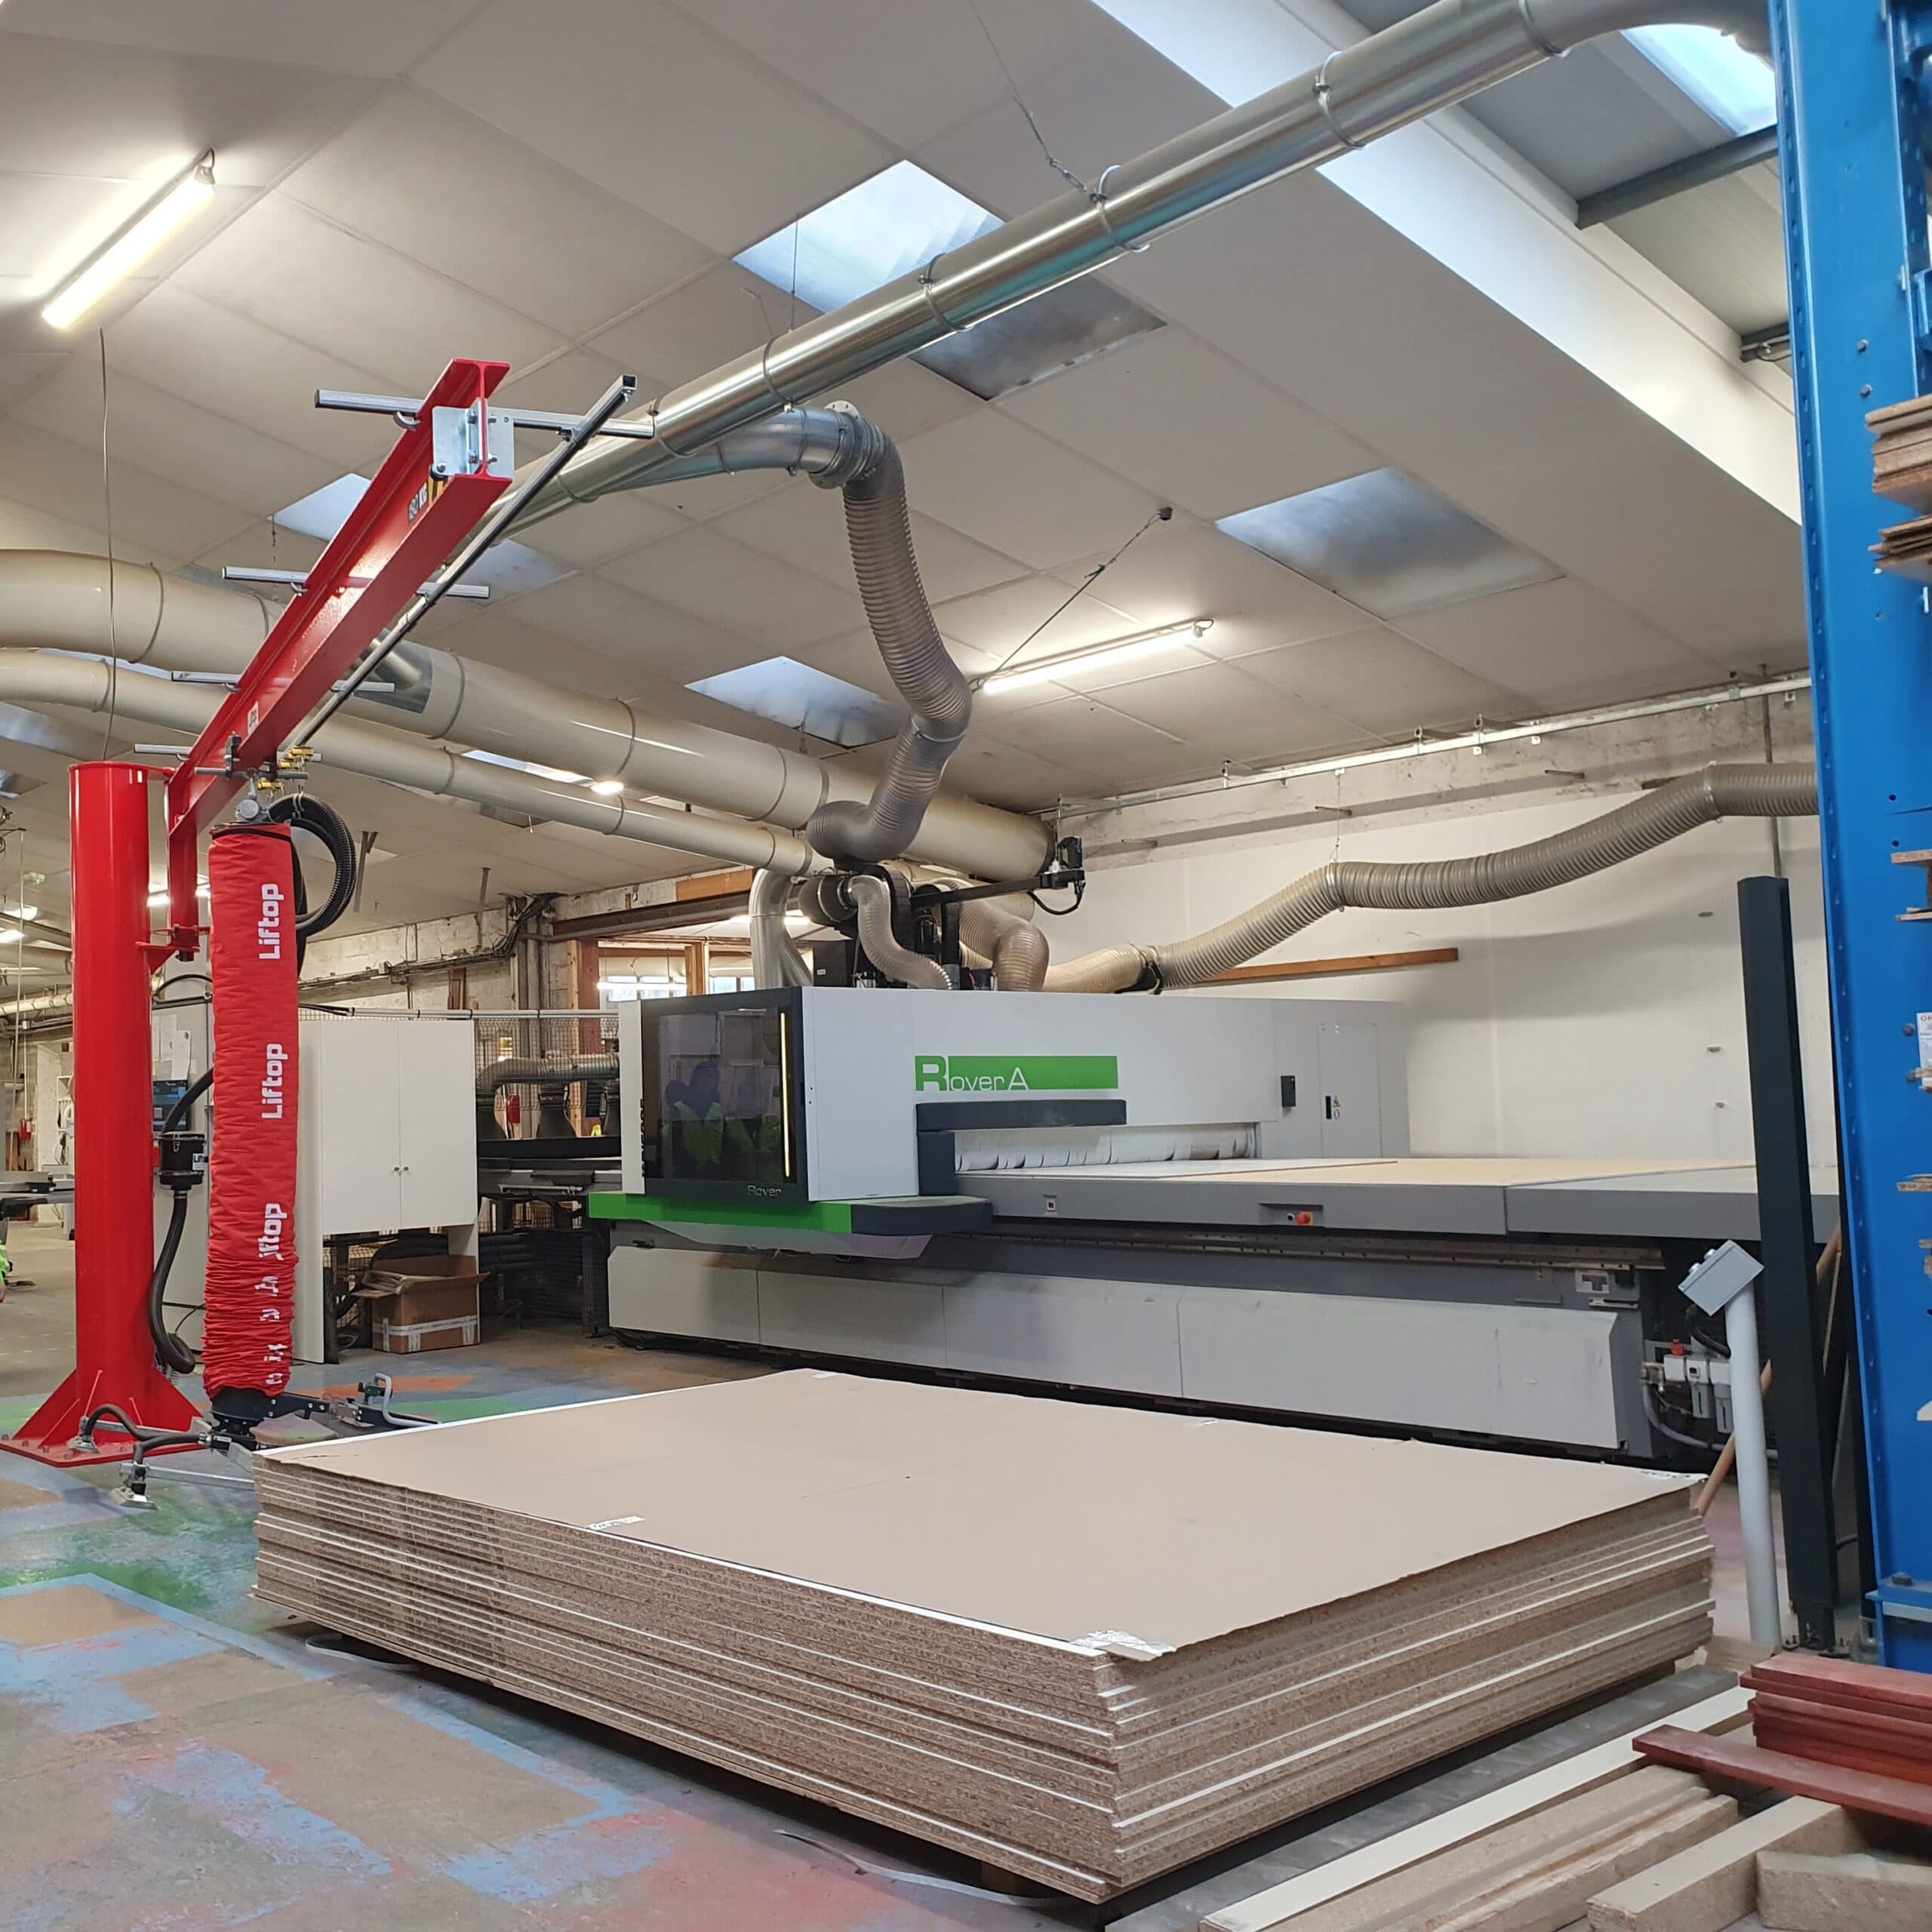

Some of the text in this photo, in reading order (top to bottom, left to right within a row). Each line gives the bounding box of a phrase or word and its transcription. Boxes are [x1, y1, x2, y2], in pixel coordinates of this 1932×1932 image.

[419, 481, 428, 509] KG
[257, 883, 285, 959] Liftop
[261, 1044, 288, 1118] Liftop
[915, 1055, 1030, 1091] Rover A
[747, 1185, 782, 1196] Rover
